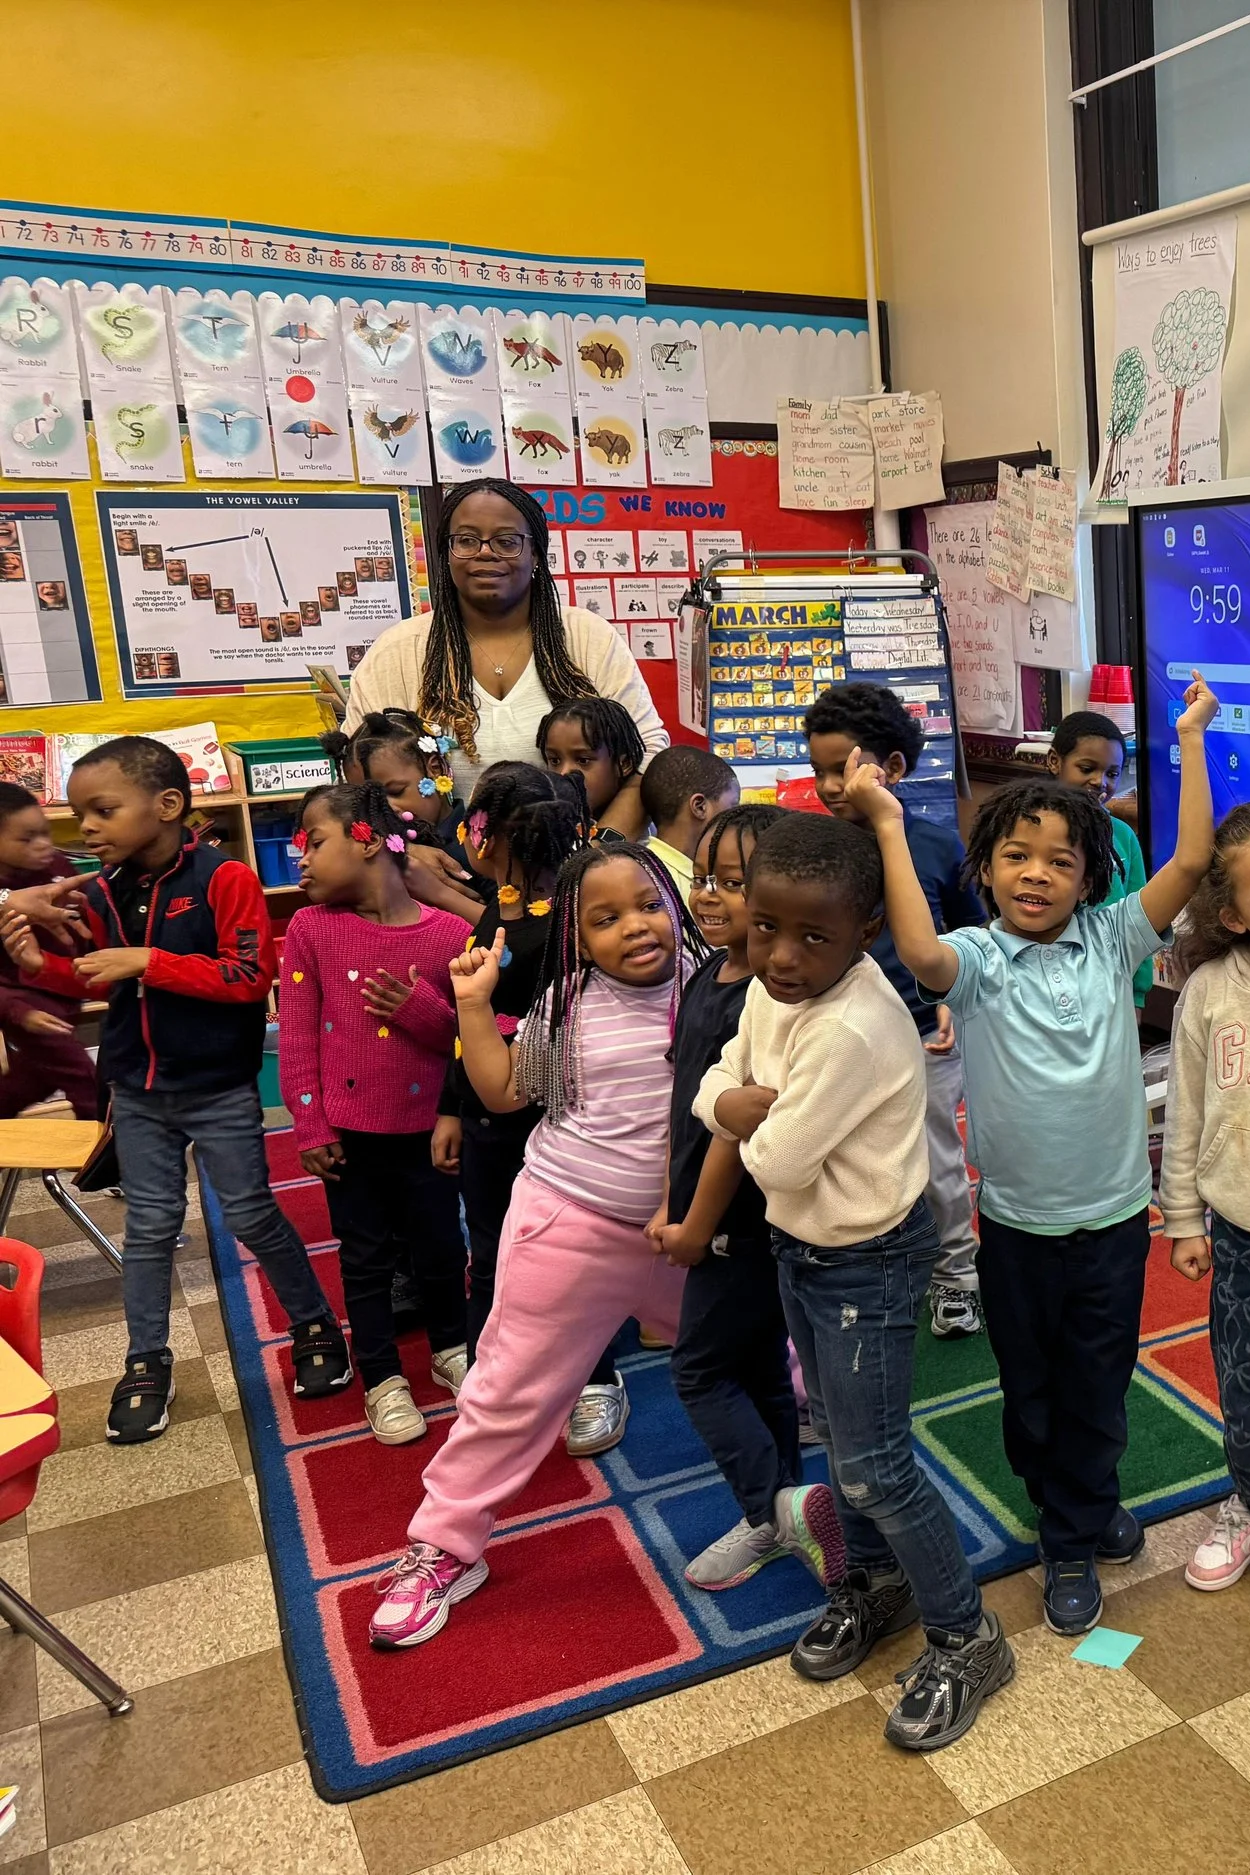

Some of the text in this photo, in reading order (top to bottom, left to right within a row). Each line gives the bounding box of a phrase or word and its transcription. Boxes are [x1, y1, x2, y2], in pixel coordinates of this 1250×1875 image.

[16, 226, 642, 291] 72 74 76 78 80 82 84 86 88 90 92 94 96 98 100
[1117, 232, 1218, 272] Ways to enjoy trees
[18, 358, 47, 367] Rabbit
[115, 364, 141, 373] Snake
[212, 364, 229, 372] Tern
[286, 368, 321, 376] Umbrella
[371, 376, 398, 385] Vulture
[450, 377, 474, 385] Waves
[788, 398, 812, 412] Family
[790, 408, 838, 420] mom dad
[872, 405, 926, 423] park store
[791, 420, 858, 435] brother sister
[792, 438, 867, 453] grandmom cousin
[793, 465, 827, 479] kitchen
[881, 464, 908, 479] airport
[206, 496, 300, 505] THE VOWEL VALLEY
[619, 495, 652, 512] WE
[665, 501, 726, 519] KNOW
[929, 521, 981, 544] There are 26
[946, 550, 986, 568] the alphabet
[1190, 584, 1242, 624] 9:59
[716, 605, 808, 626] MARCH
[887, 623, 902, 632] was
[286, 764, 331, 779] science
[168, 896, 194, 911] NIKE
